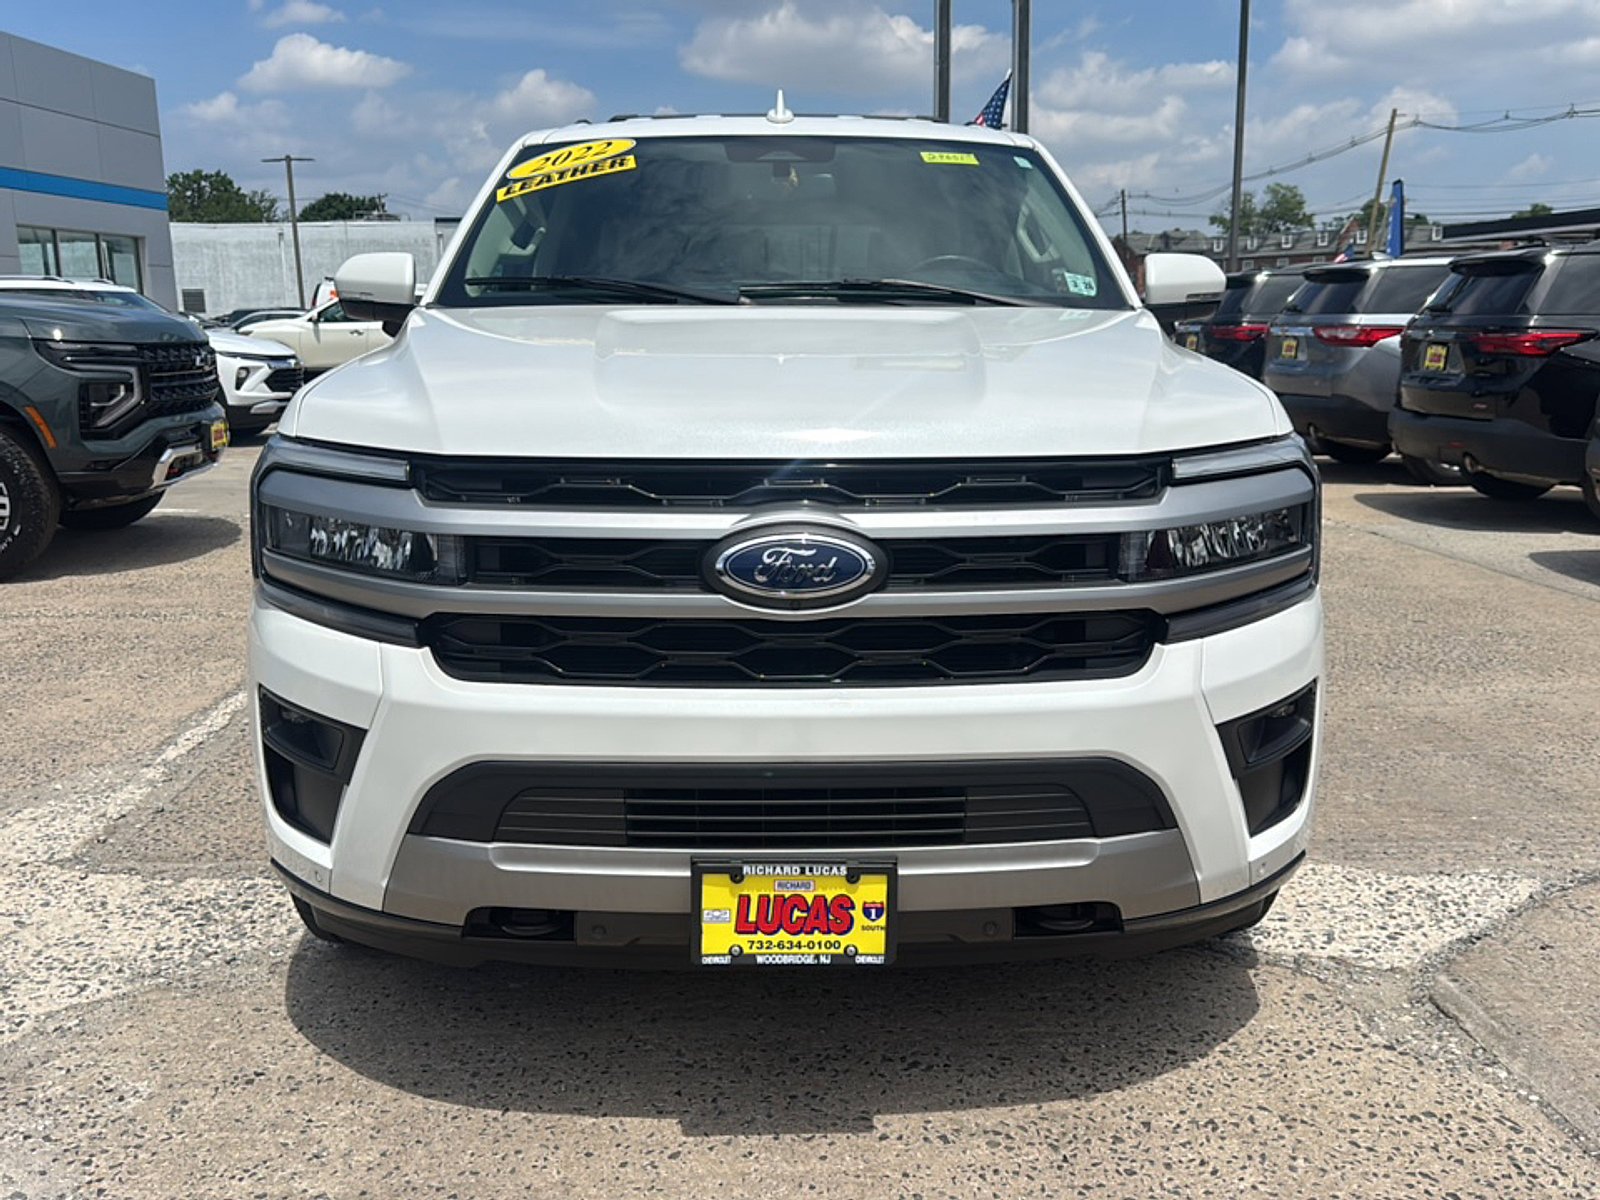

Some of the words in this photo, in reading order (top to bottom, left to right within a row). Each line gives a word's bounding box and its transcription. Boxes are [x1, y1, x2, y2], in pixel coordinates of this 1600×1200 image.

[530, 141, 613, 173] 2022
[502, 157, 629, 197] LEATHER
[753, 546, 838, 584] Ford
[743, 865, 801, 876] RICHARD
[804, 865, 848, 876] LUCAS
[776, 881, 812, 891] RICHARD
[734, 893, 855, 935] LUCAS
[869, 909, 878, 921] 1
[747, 940, 842, 951] 732-634-0100
[819, 955, 832, 965] NJ
